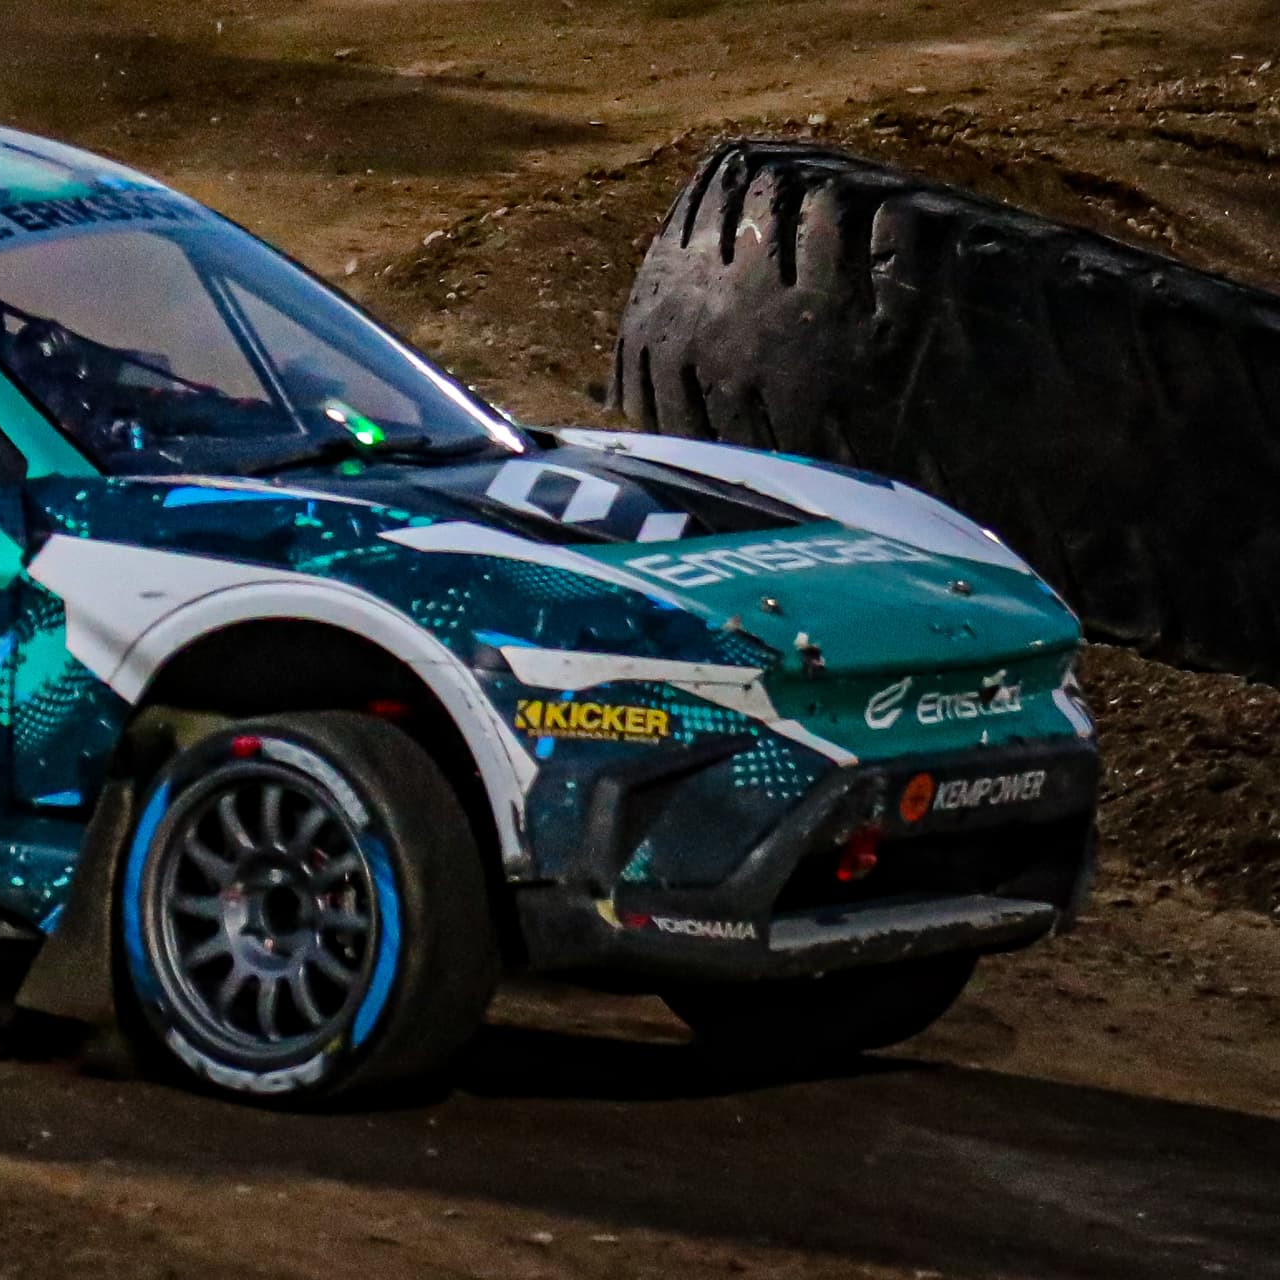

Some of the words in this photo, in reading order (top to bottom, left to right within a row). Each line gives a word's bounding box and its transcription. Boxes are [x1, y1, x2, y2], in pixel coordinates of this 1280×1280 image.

[544, 701, 670, 737] KICKER
[933, 770, 1046, 811] KEMPOWER
[649, 914, 758, 940] YOKOHAMA
